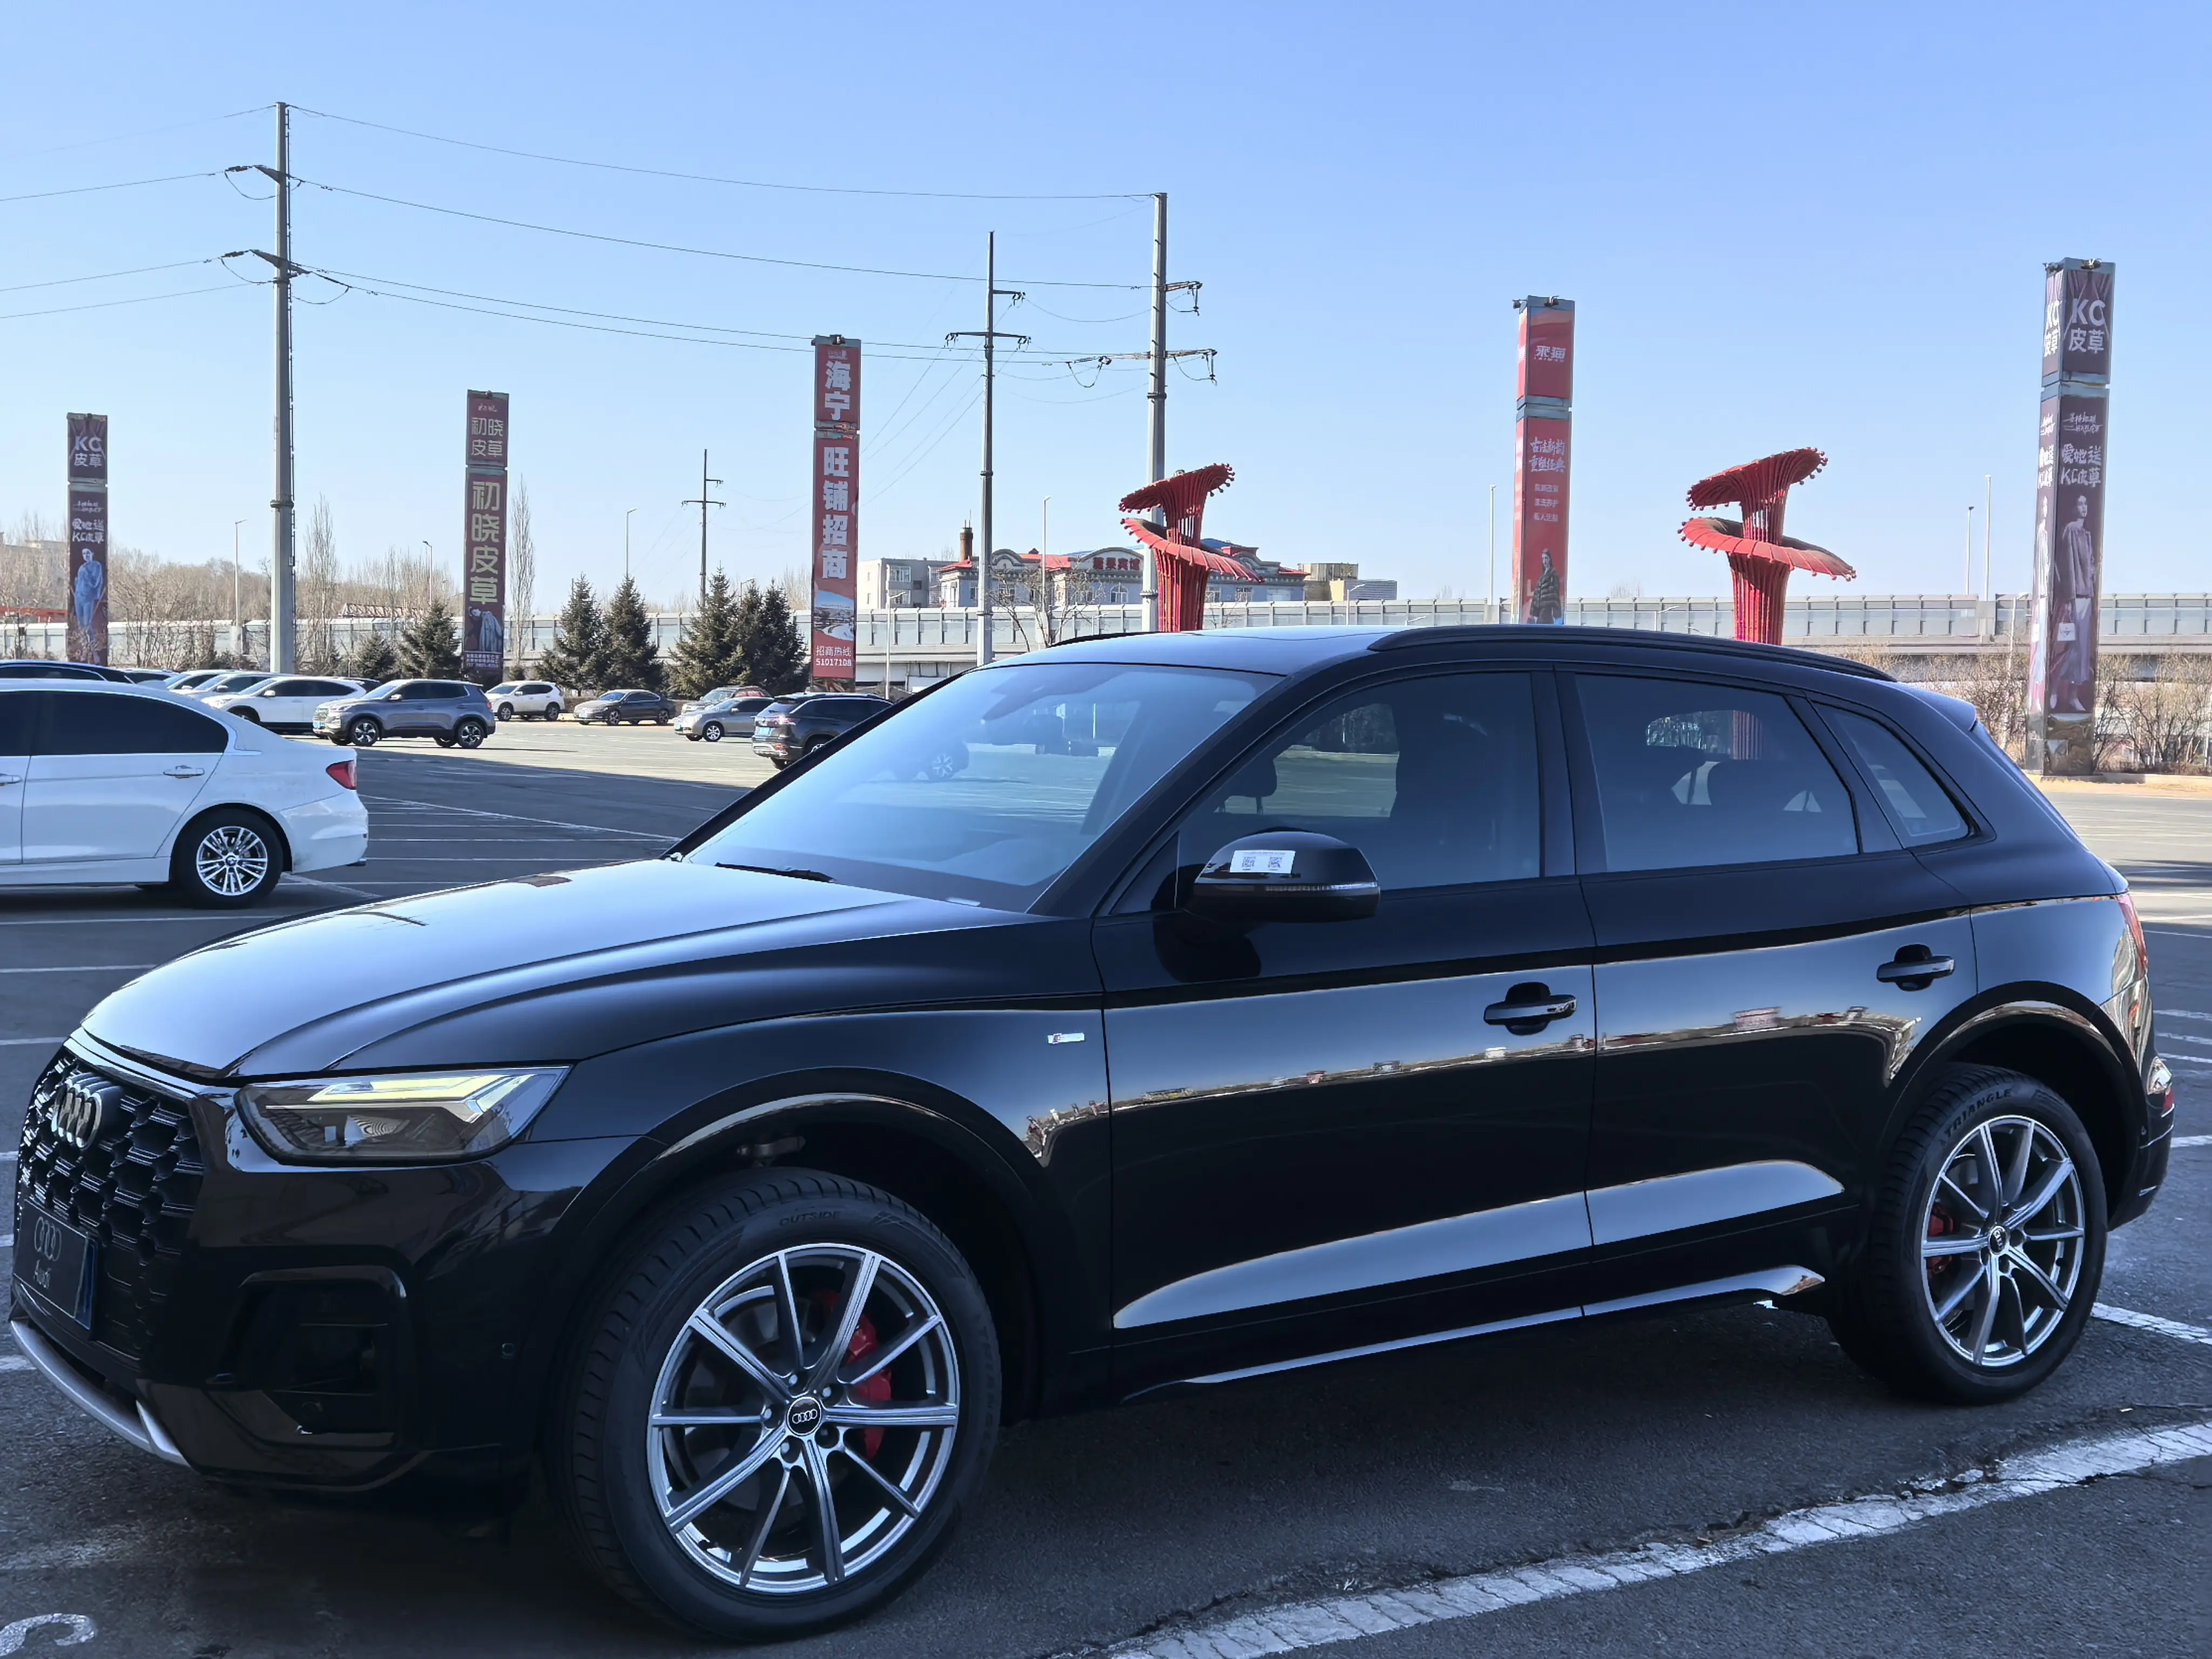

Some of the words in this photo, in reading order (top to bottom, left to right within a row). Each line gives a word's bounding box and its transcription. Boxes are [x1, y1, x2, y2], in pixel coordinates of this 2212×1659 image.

[2072, 298, 2106, 326] KC
[2069, 328, 2105, 354] 皮草
[825, 360, 851, 421] 海宁
[471, 417, 503, 436] 初晓
[75, 436, 102, 451] KC
[471, 439, 503, 457] 皮草
[74, 453, 102, 467] 皮草
[821, 447, 849, 579] 旺铺招商
[469, 481, 501, 604] 初晓皮草
[816, 645, 852, 656] 招商热线
[1944, 1089, 2013, 1138] TRIANGLE
[779, 1211, 841, 1226] OUTSIDE
